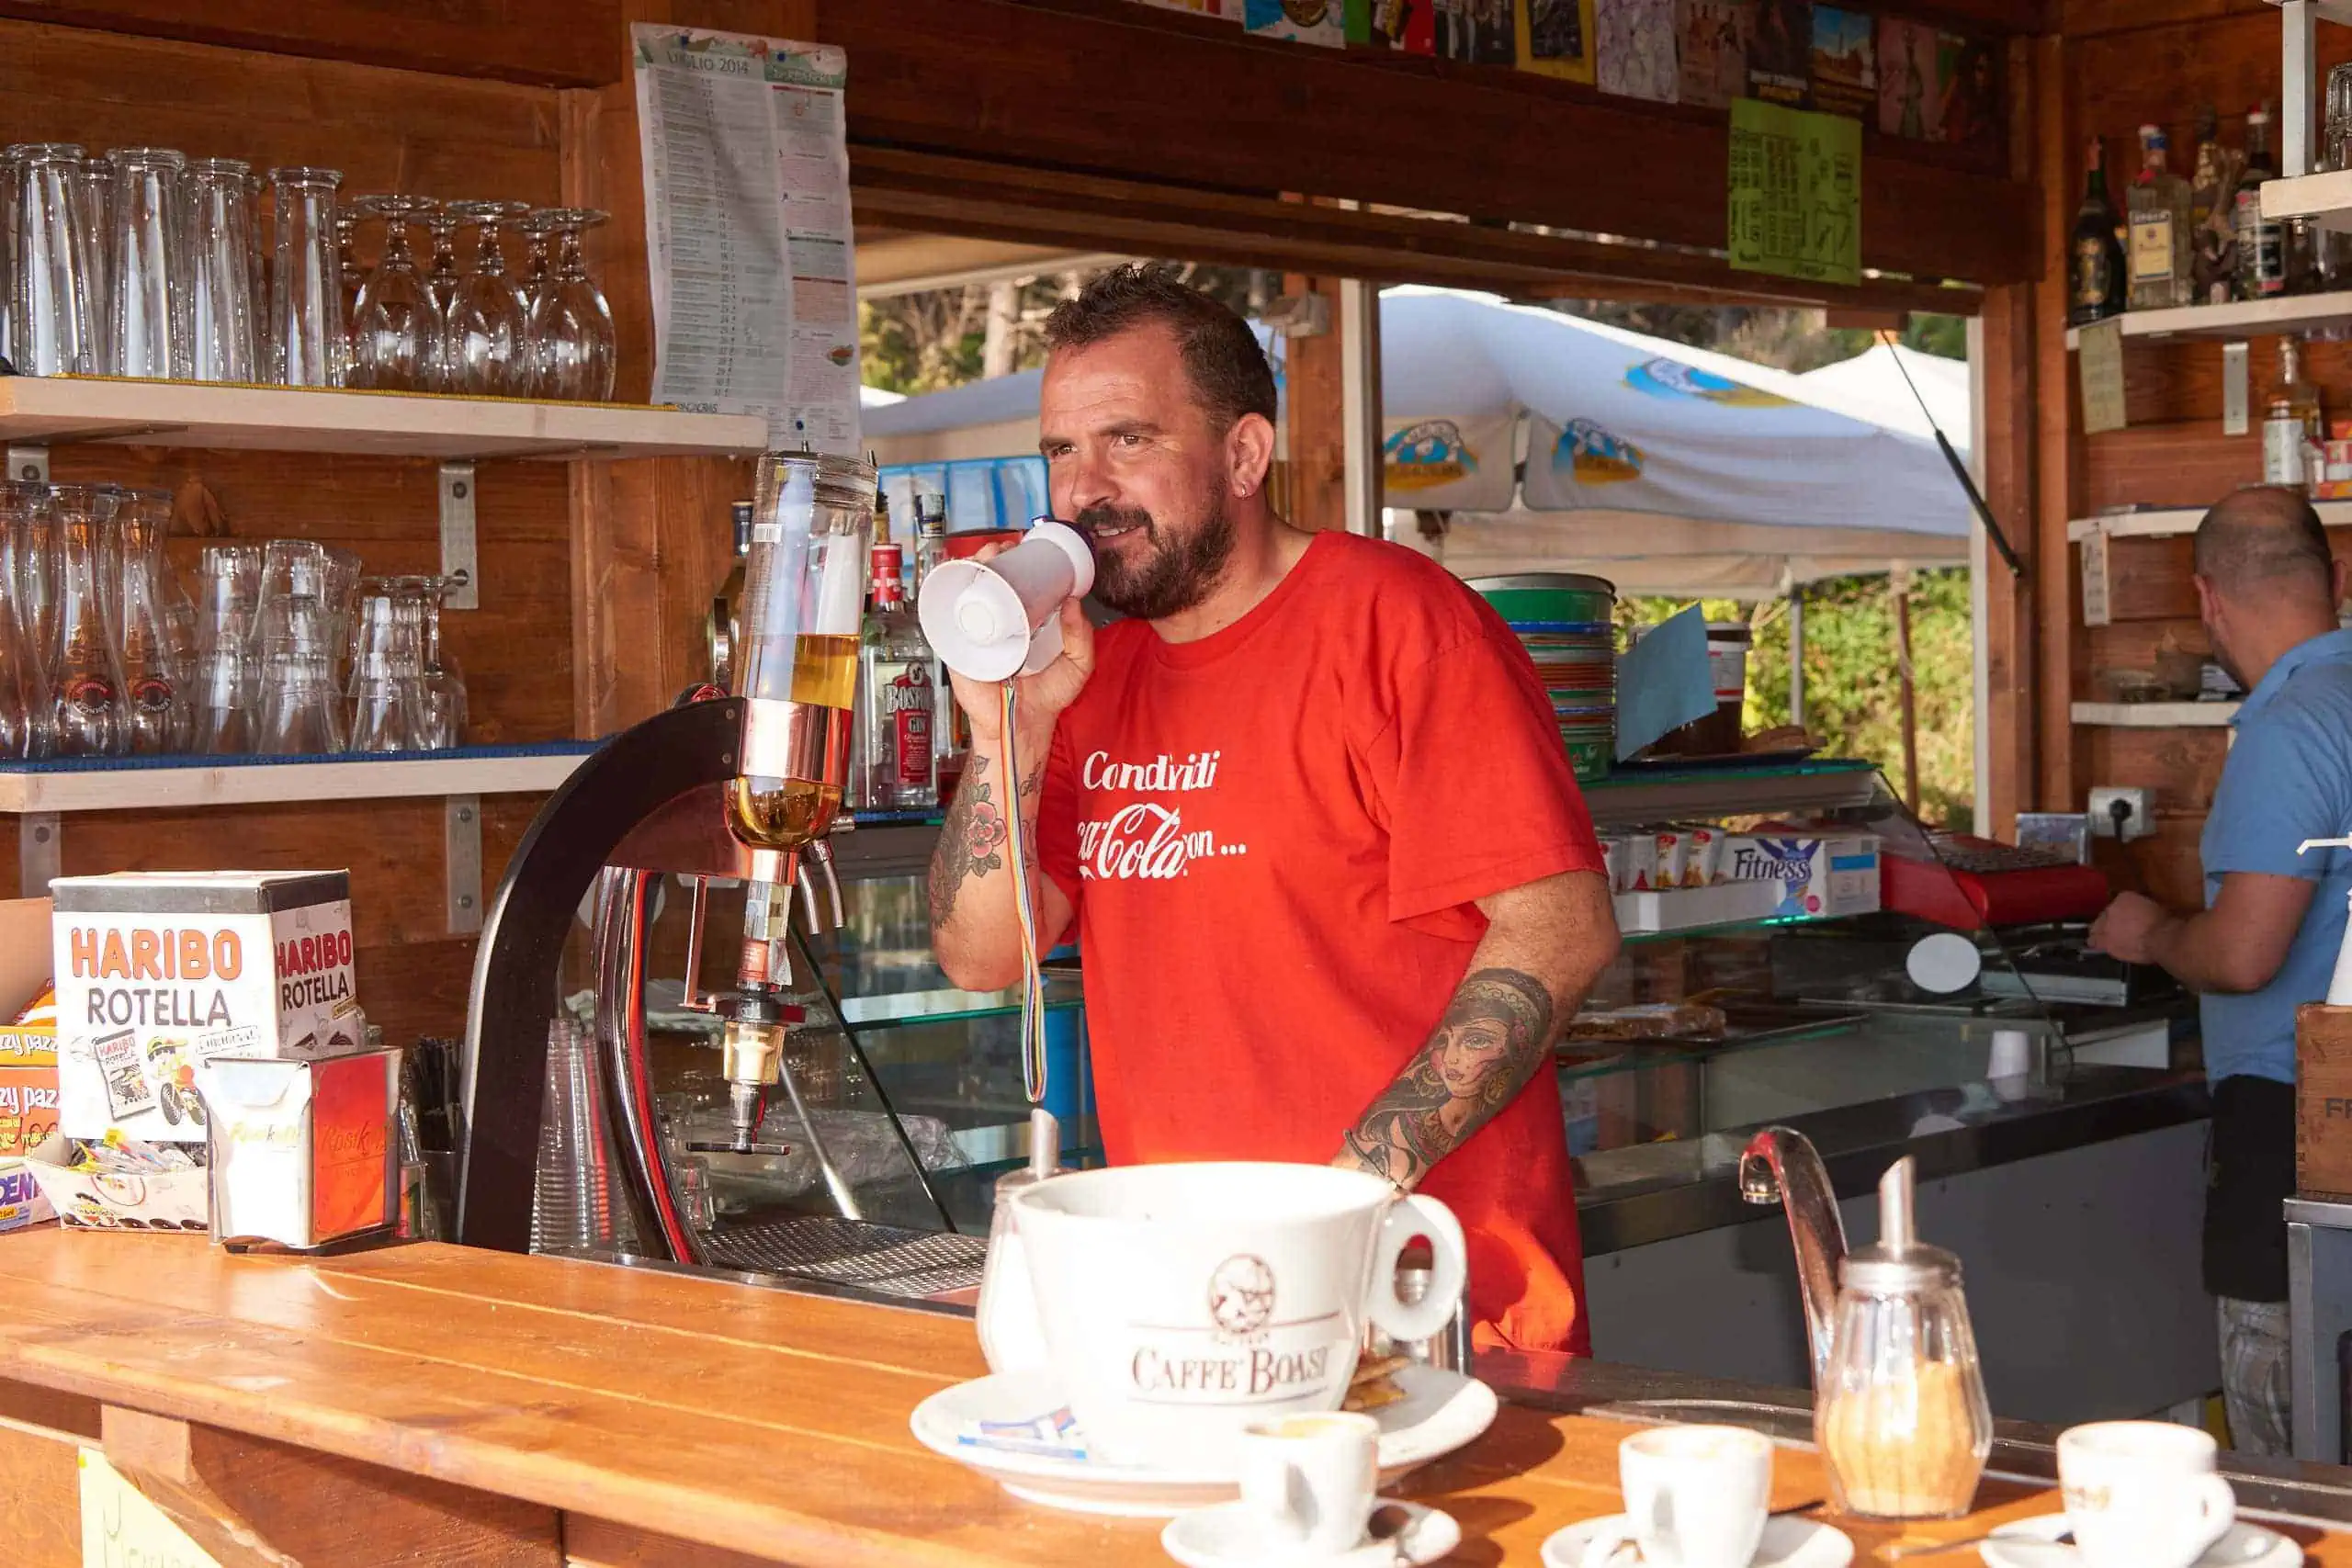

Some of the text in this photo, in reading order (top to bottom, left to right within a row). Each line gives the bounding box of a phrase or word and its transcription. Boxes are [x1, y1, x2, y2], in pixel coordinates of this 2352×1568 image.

[719, 58, 749, 74] 2014
[1734, 848, 1812, 882] Fitness
[71, 927, 243, 981] HARIBO
[276, 929, 352, 979] HARIBO
[87, 987, 232, 1026] ROTELLA
[282, 971, 349, 1011] ROTELLA
